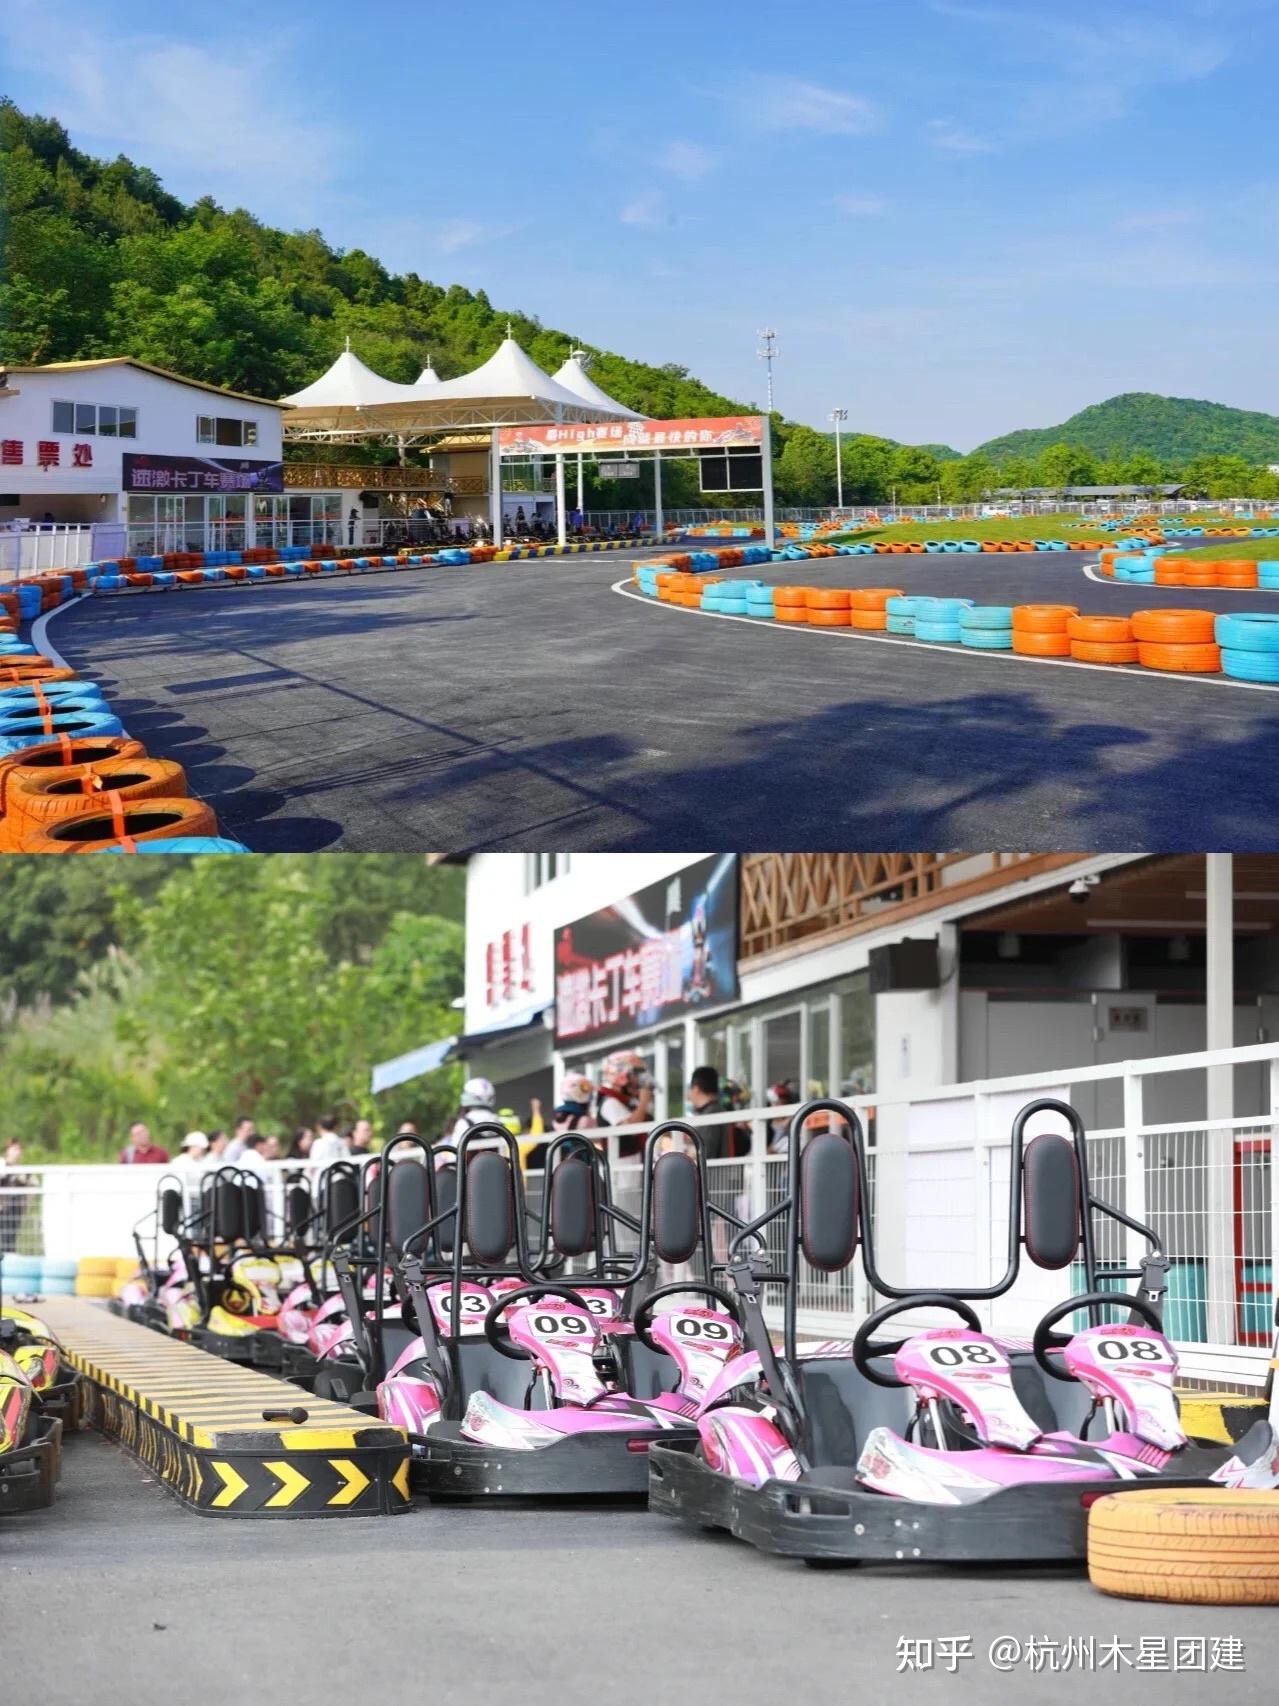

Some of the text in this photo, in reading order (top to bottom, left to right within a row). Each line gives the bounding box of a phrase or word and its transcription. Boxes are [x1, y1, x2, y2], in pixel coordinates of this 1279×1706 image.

[1, 440, 93, 471] 售票处
[440, 1293, 487, 1314] 03
[533, 1315, 589, 1336] 09
[675, 1317, 730, 1341] 09
[930, 1344, 997, 1366] 08
[1097, 1339, 1163, 1361] 08
